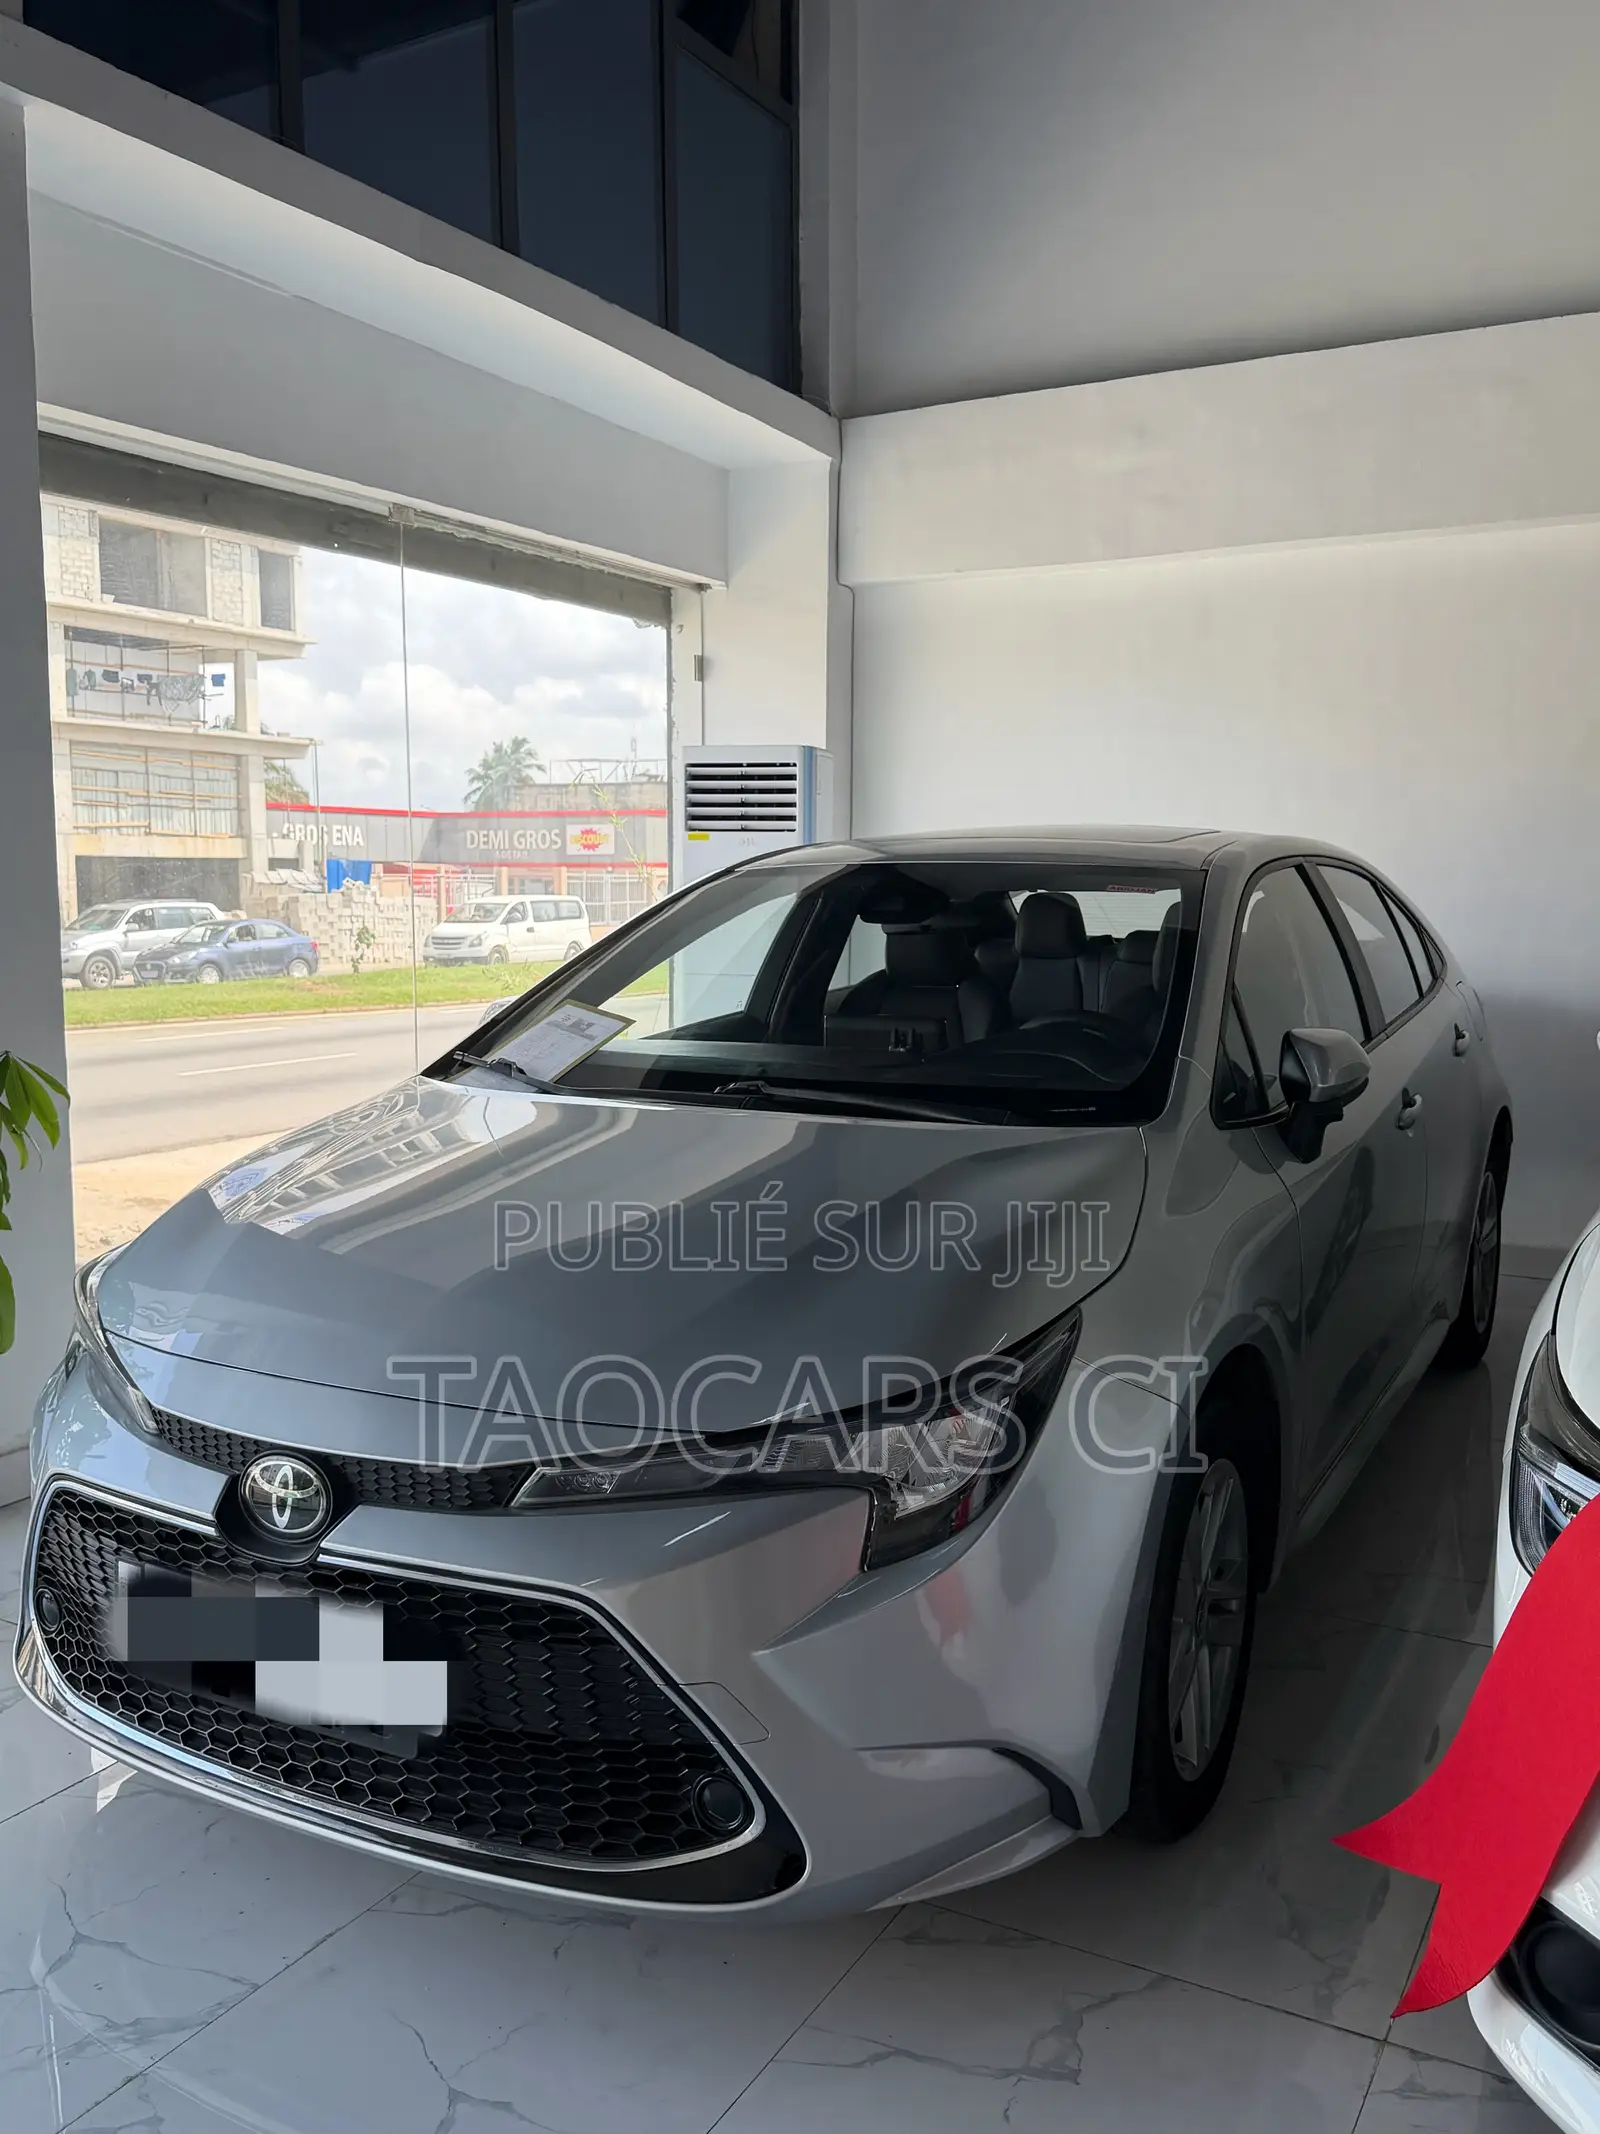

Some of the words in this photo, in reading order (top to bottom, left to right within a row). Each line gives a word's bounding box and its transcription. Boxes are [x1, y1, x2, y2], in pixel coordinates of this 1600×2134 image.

[332, 824, 365, 847] ENA
[466, 829, 509, 849] DEMI
[513, 829, 562, 849] GROS
